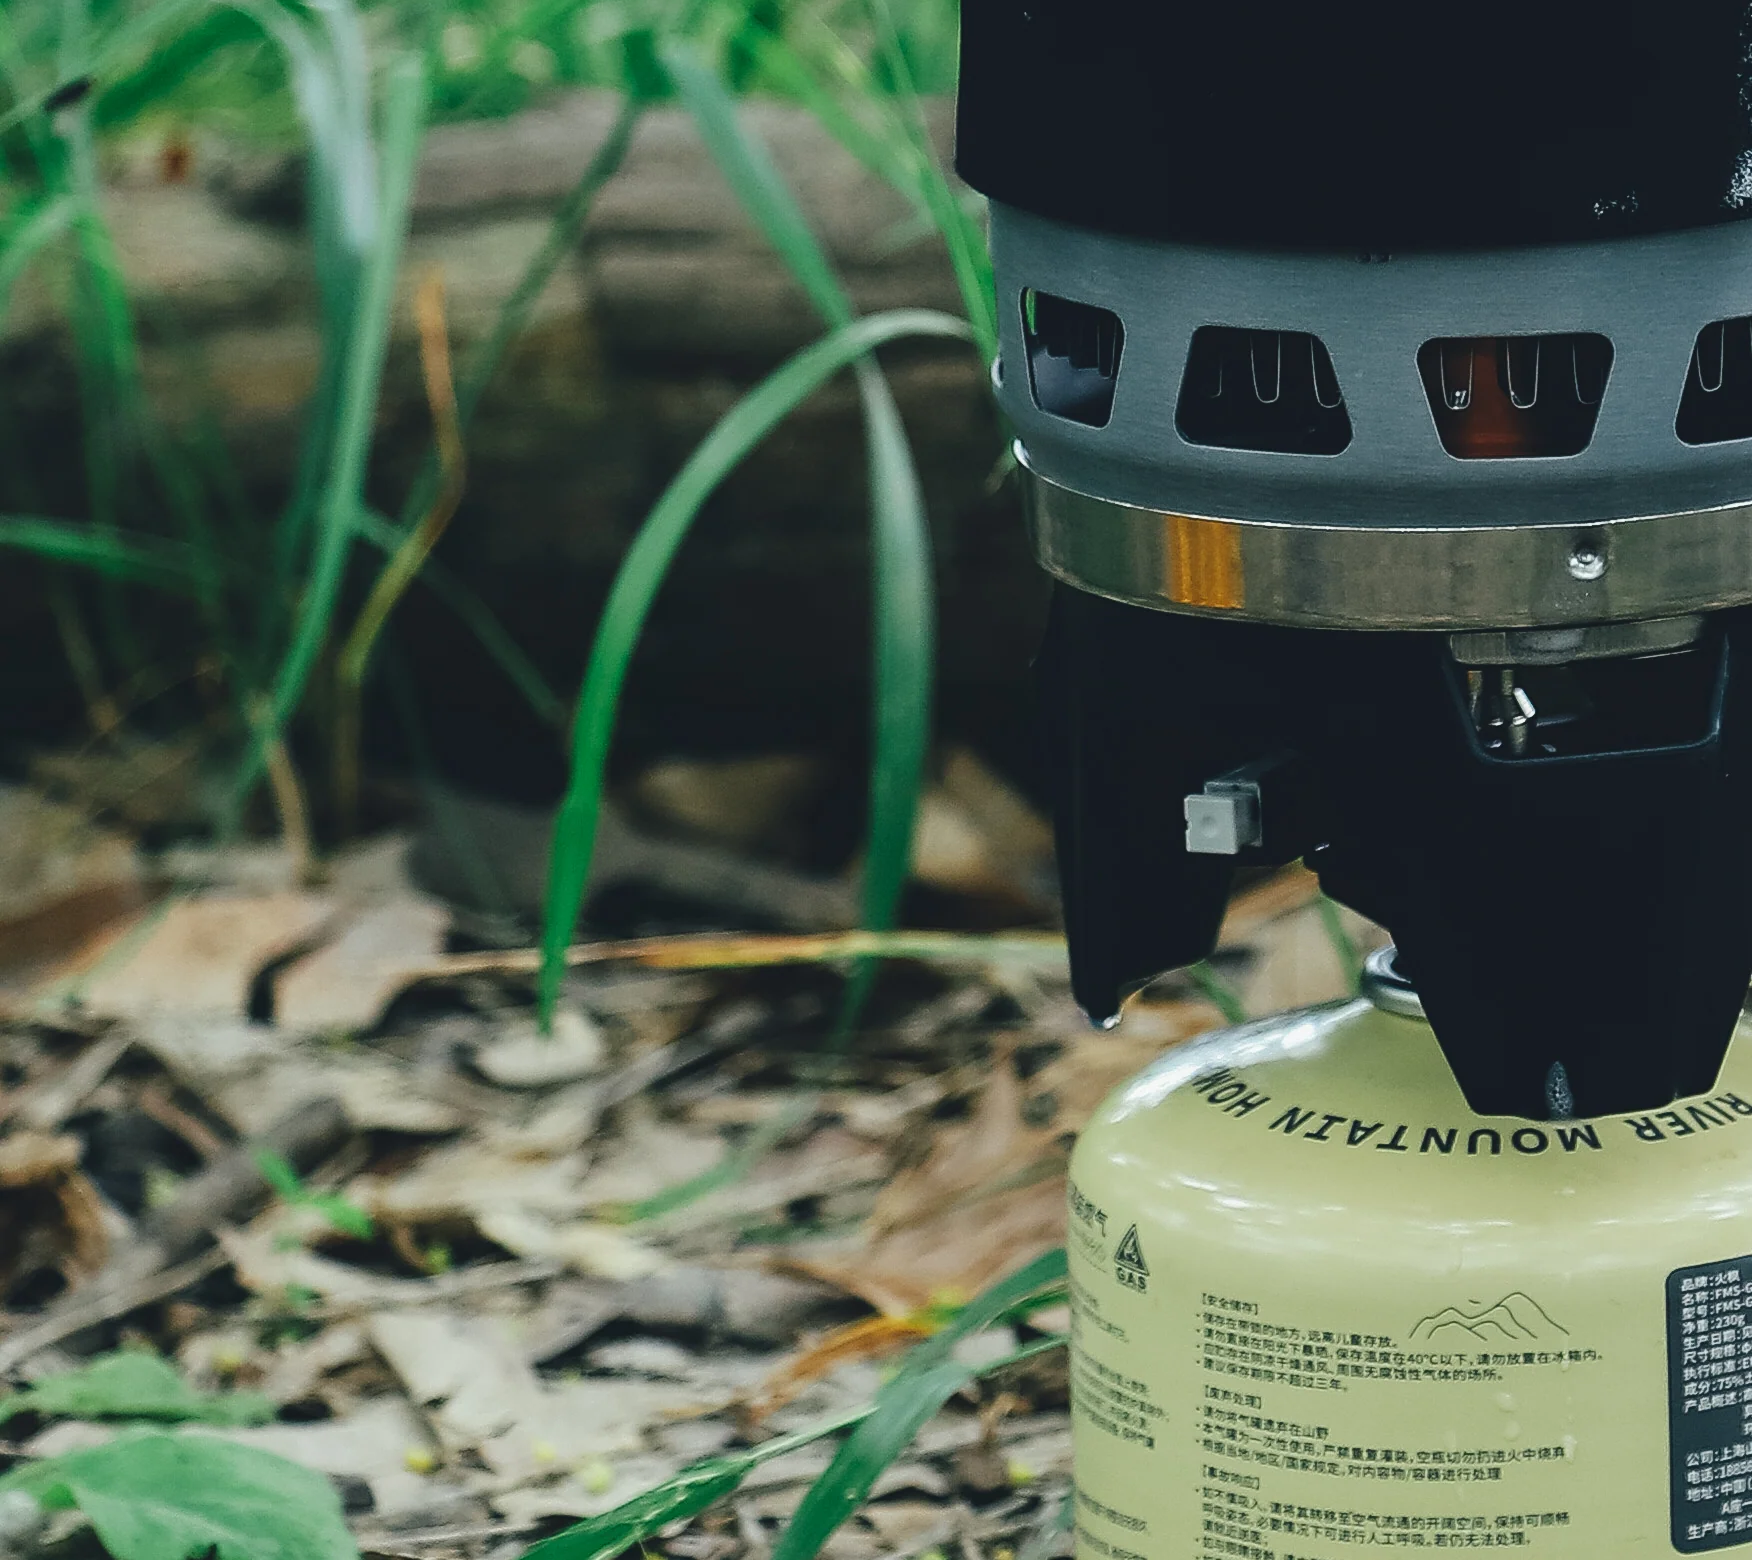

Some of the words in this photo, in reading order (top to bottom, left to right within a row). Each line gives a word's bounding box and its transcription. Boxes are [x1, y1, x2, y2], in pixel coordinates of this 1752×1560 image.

[1192, 1068, 1271, 1118] HOM
[1269, 1106, 1602, 1156] MOUNTAIN
[1116, 1267, 1147, 1290] GAS
